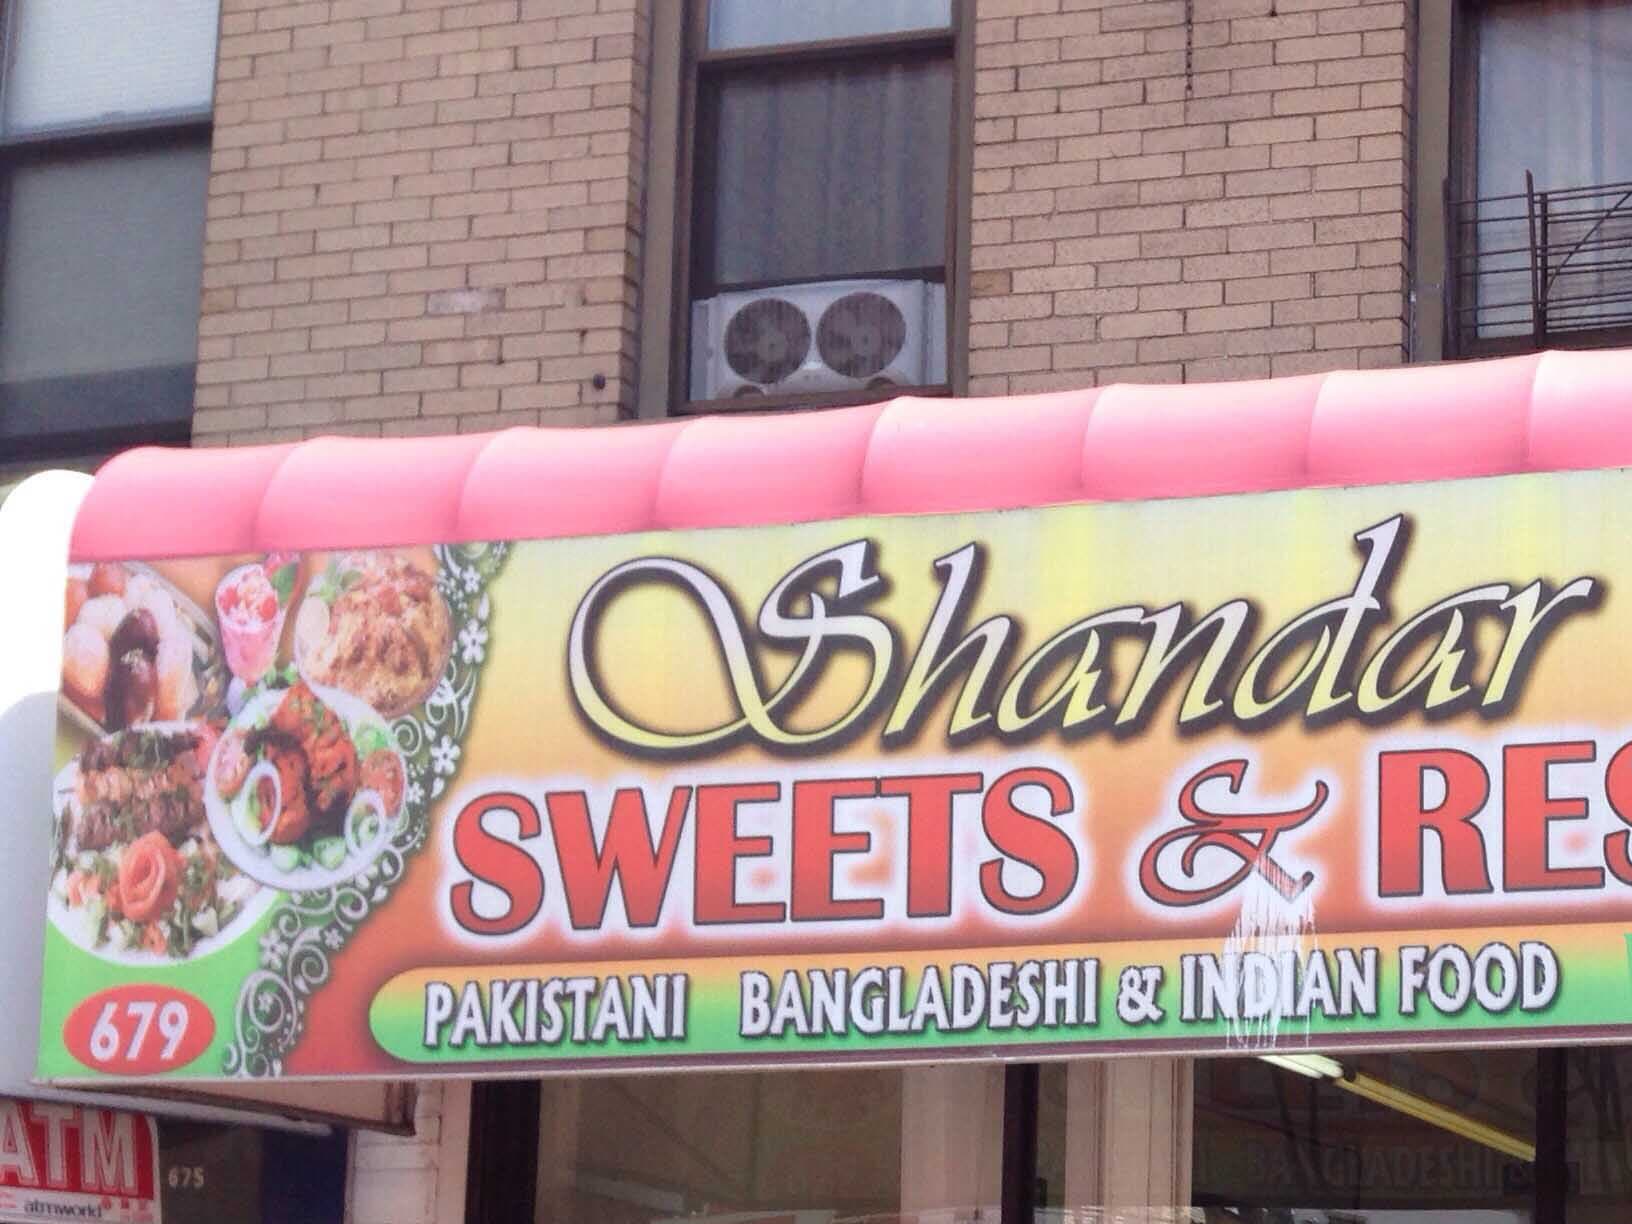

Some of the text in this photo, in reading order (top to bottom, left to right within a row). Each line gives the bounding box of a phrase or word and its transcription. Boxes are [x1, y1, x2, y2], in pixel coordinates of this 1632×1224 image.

[568, 513, 1598, 752] Shandar
[449, 765, 1081, 937] SWEETS
[1138, 758, 1330, 907] &
[89, 1002, 189, 1062] 679
[423, 941, 1560, 1049] PAKISTANI BANGLADESHI & INDIAN FOOD
[0, 1100, 139, 1195] ATM
